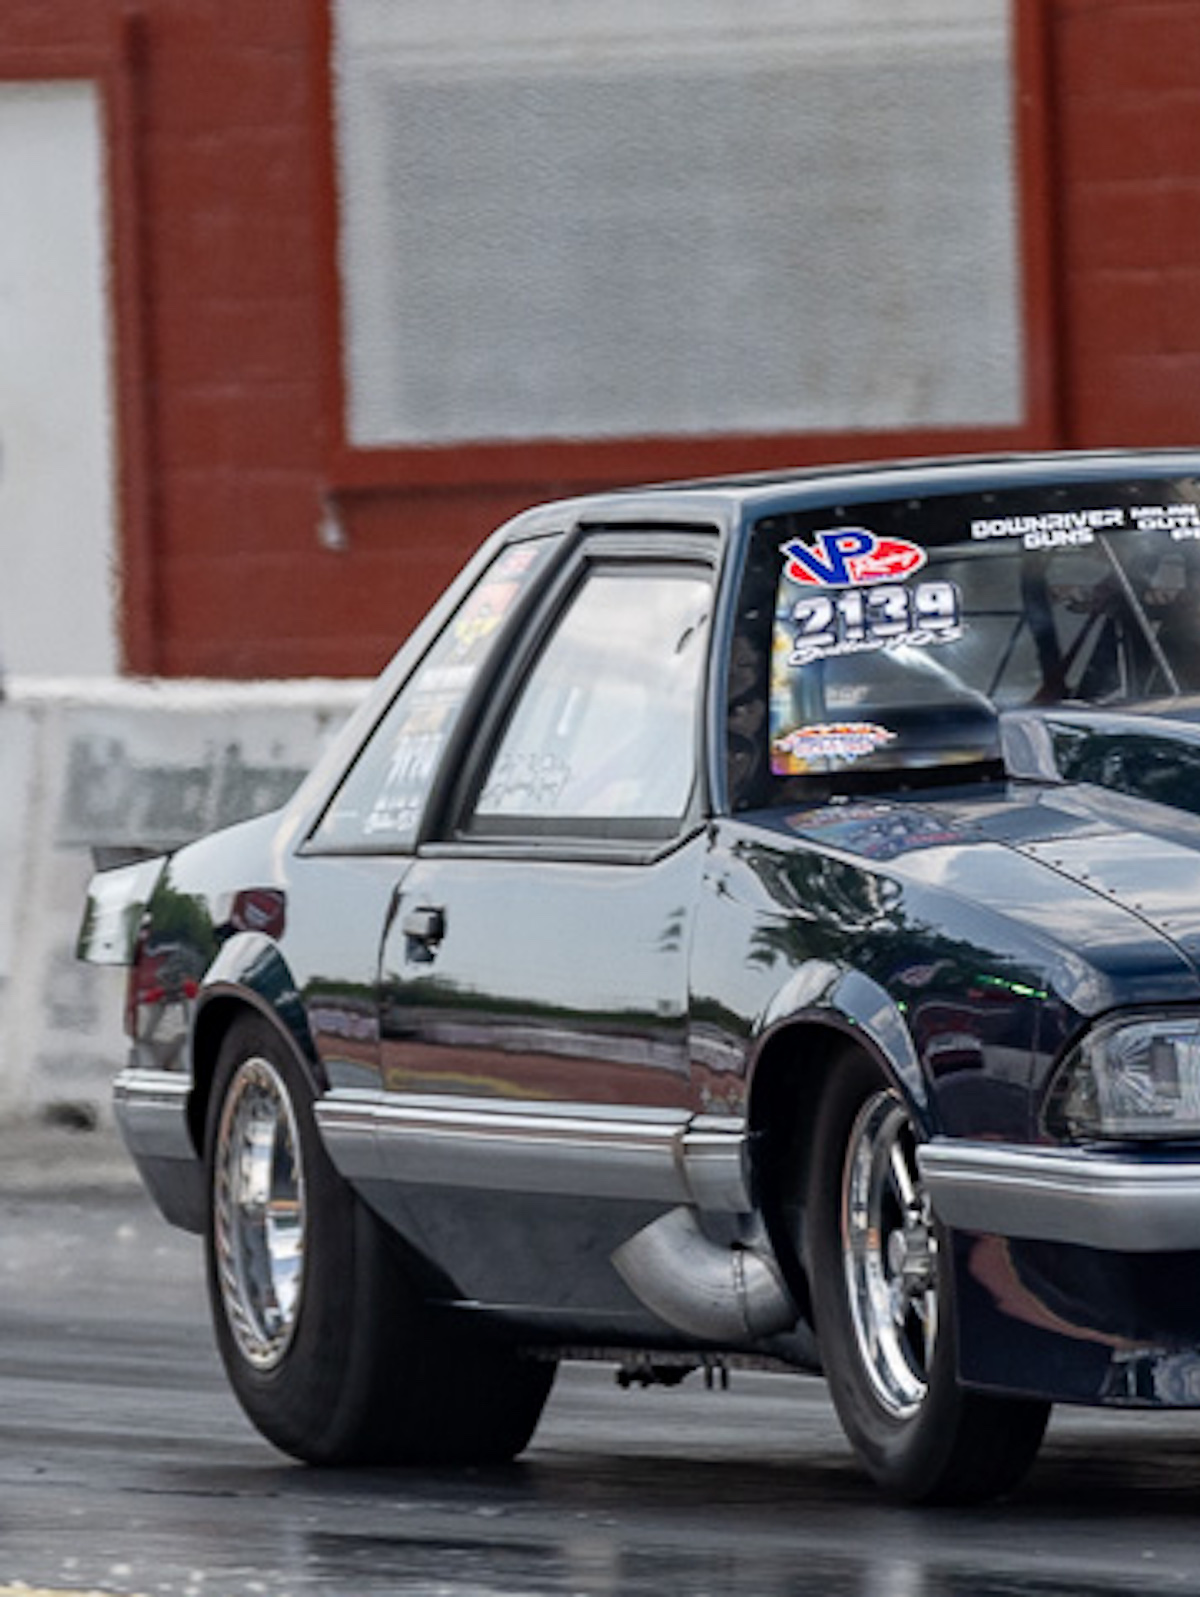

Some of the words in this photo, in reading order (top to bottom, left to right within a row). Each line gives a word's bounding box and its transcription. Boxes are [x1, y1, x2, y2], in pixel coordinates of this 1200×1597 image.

[971, 509, 1125, 540] DOWNRIVER
[1024, 527, 1095, 549] GUNS
[784, 528, 878, 586] VP
[792, 581, 958, 649] 2139
